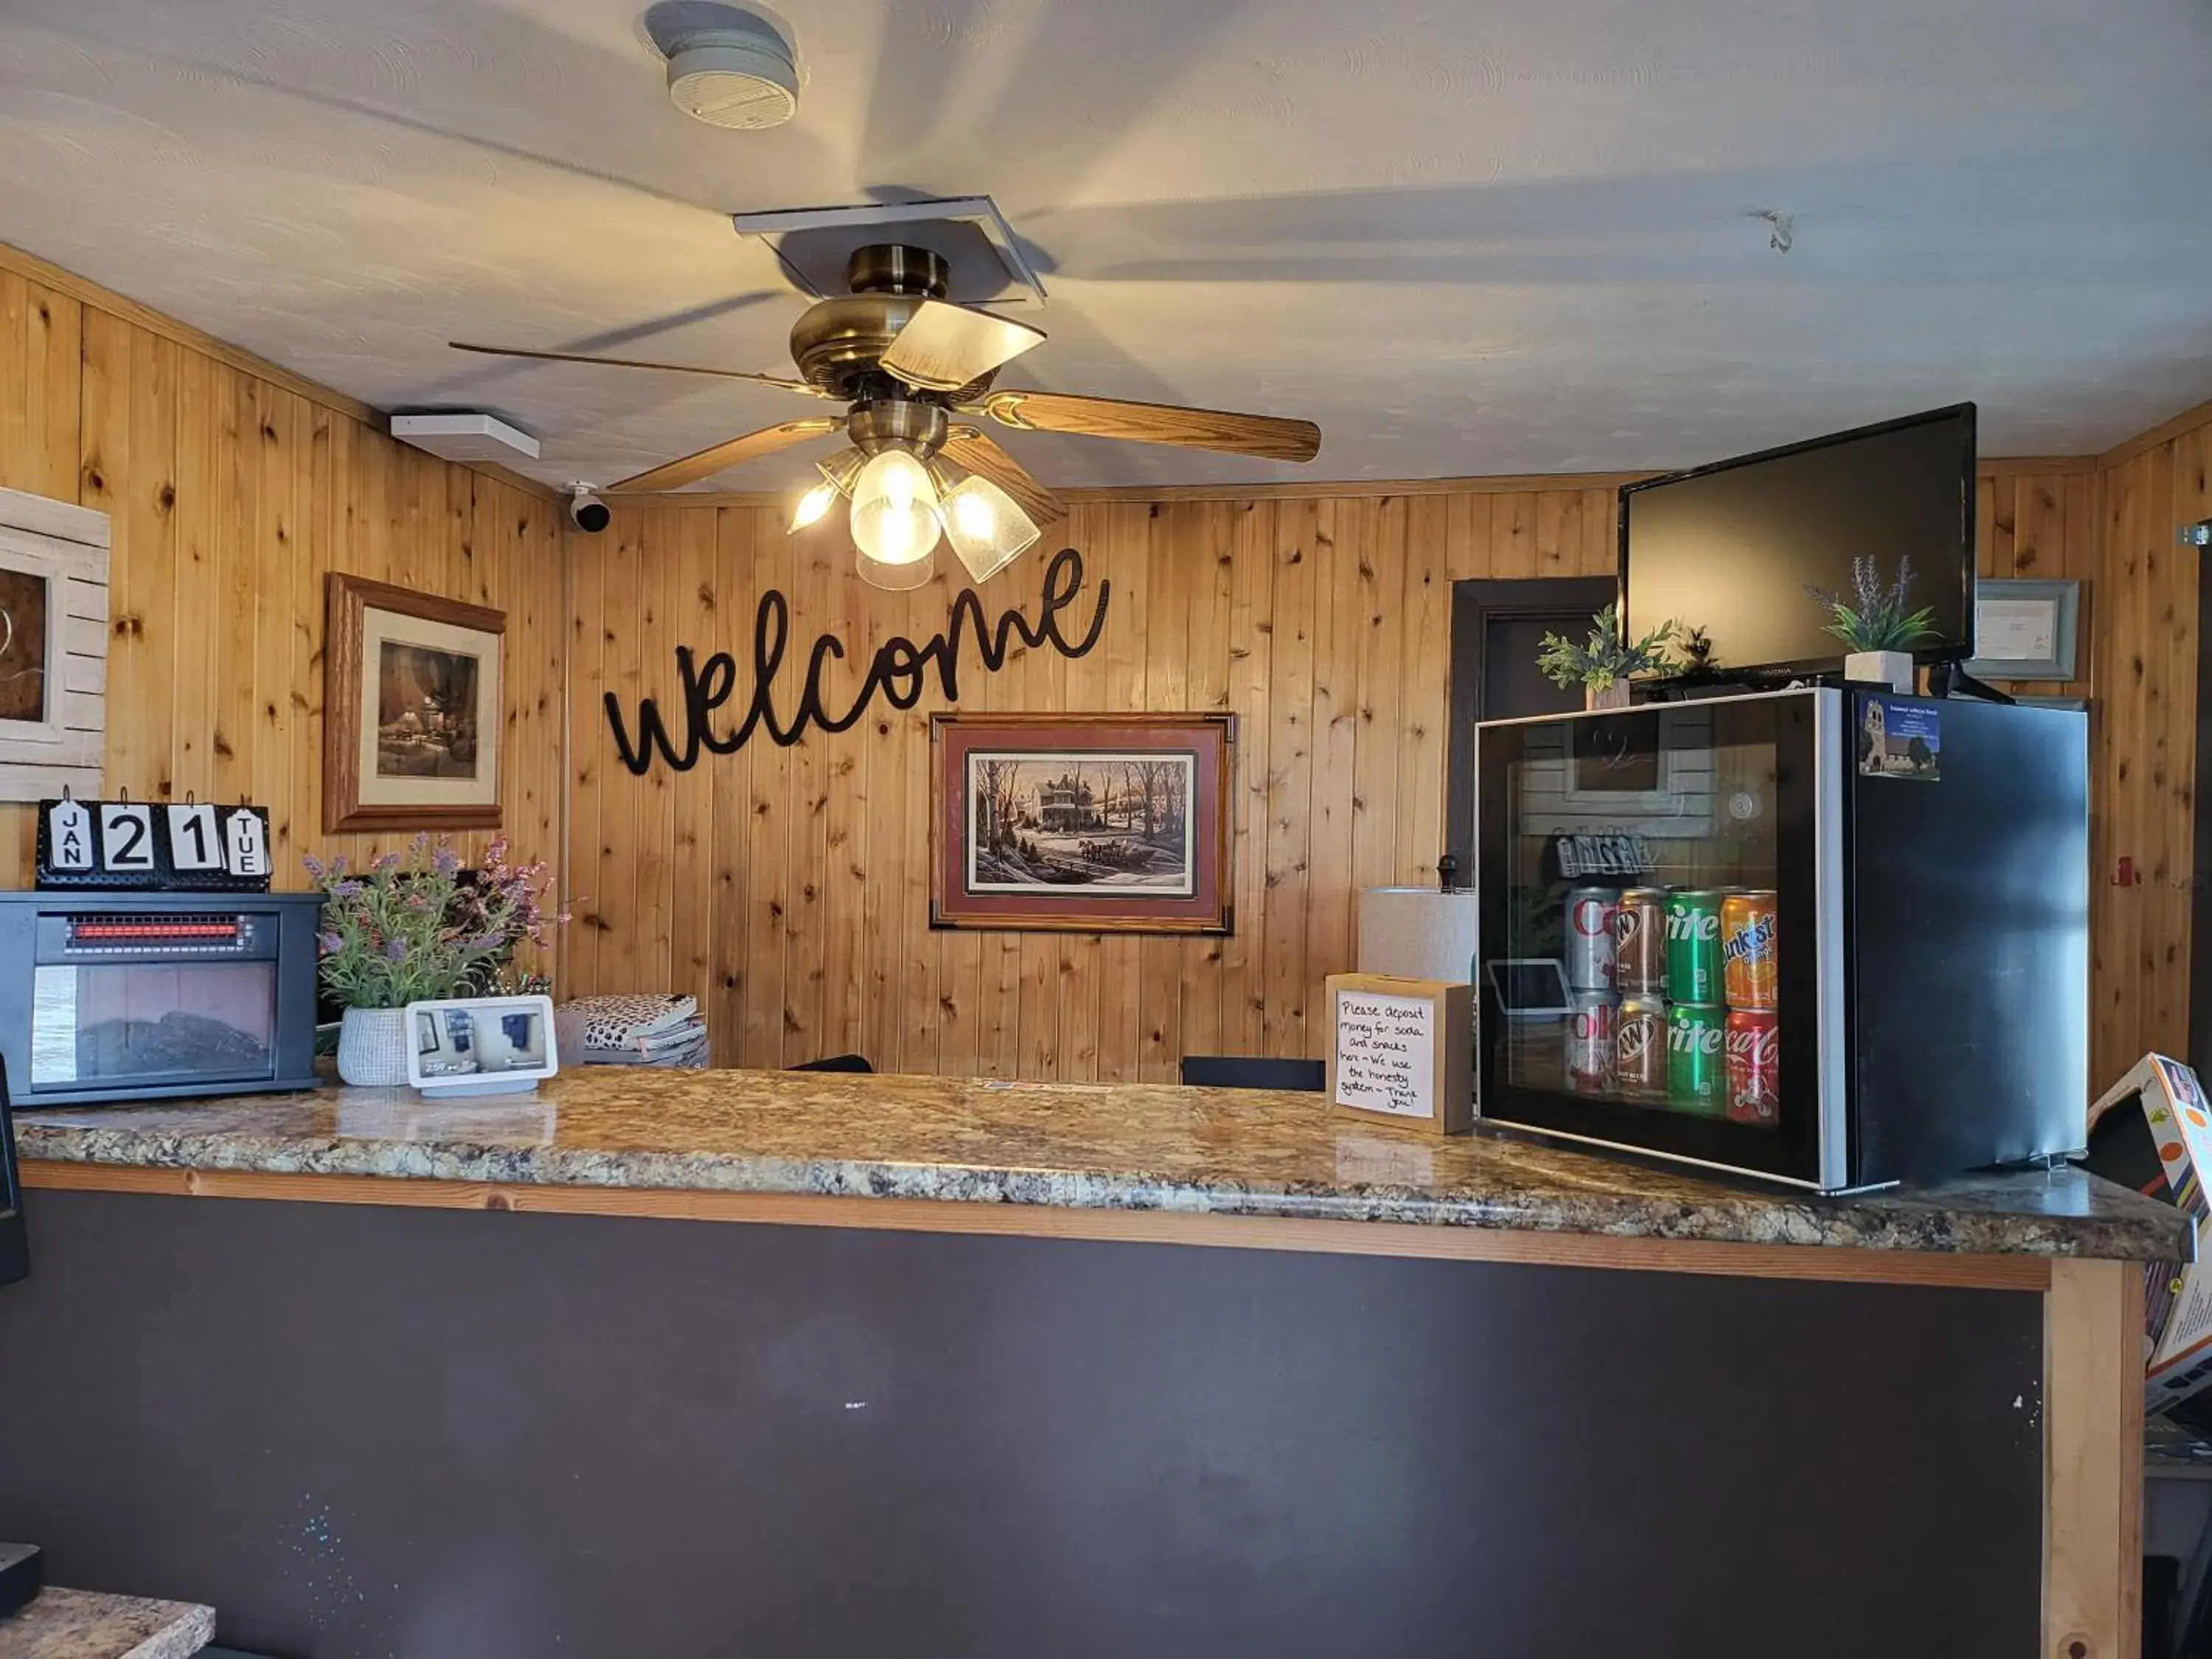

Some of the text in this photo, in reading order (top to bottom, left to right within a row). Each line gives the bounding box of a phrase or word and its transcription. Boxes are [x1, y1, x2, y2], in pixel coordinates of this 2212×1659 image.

[604, 548, 1110, 776] welcome
[62, 812, 81, 863] JAN
[237, 818, 257, 872] TUE
[1666, 904, 1719, 941] rite
[1341, 1001, 1425, 1022] Please deposit
[1374, 1021, 1389, 1035] for
[1394, 1026, 1425, 1037] soda
[1667, 1018, 1723, 1054] rite
[1371, 1040, 1408, 1052] snacks
[1370, 1053, 1385, 1066] We
[1391, 1060, 1411, 1070] use
[1349, 1065, 1409, 1089] the honesty
[1340, 1081, 1373, 1096] system
[1384, 1087, 1418, 1098] Thank
